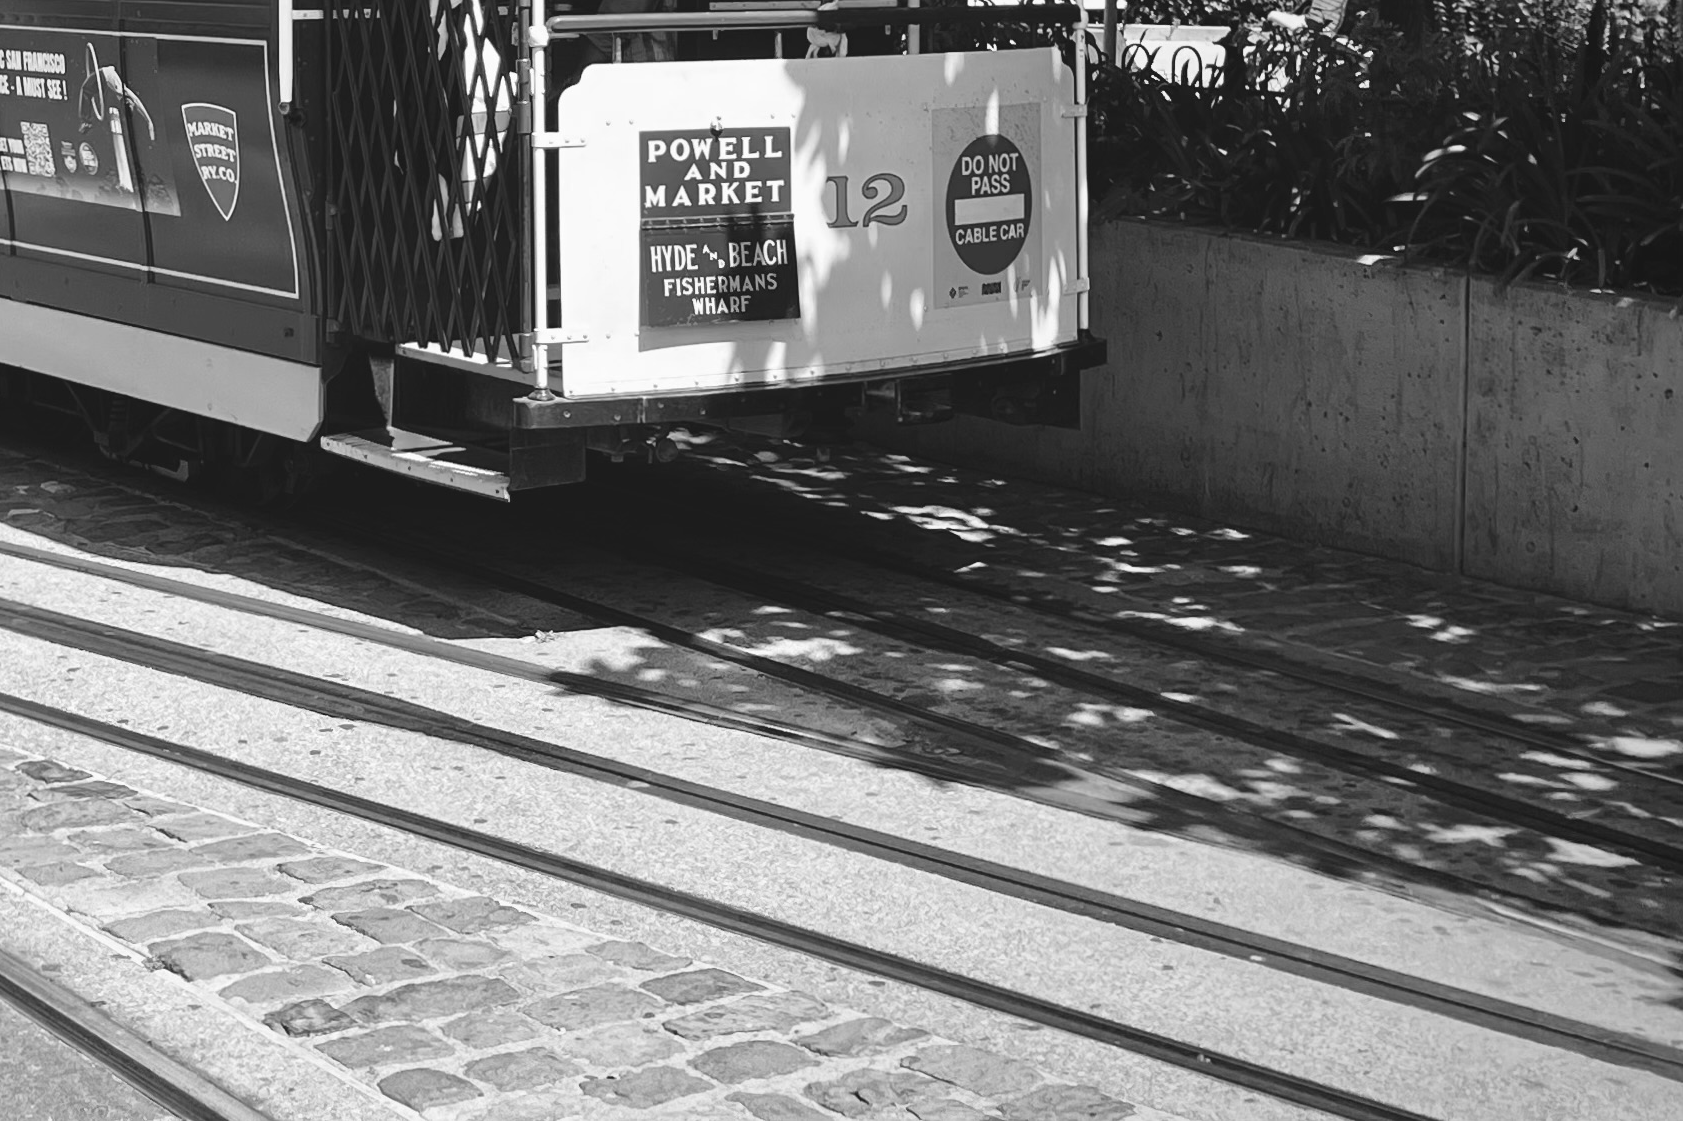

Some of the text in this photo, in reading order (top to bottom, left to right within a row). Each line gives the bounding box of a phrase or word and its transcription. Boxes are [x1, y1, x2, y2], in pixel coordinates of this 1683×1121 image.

[5, 49, 22, 71] SAN
[22, 50, 66, 74] FRANCISCO
[16, 75, 23, 96] A
[23, 76, 46, 98] MUST
[187, 122, 234, 141] MARKET
[194, 143, 236, 163] STREET
[648, 136, 783, 163] POWELL
[684, 161, 751, 181] AND
[961, 152, 1019, 176] DO NOT
[644, 180, 785, 208] MARKET
[971, 174, 1011, 196] PASS
[826, 172, 908, 228] 12
[955, 223, 1025, 245] CABLE CAR
[650, 239, 788, 273] HYDE AND BEACH
[663, 273, 778, 297] FISHERMANS
[692, 295, 752, 315] WHARF
